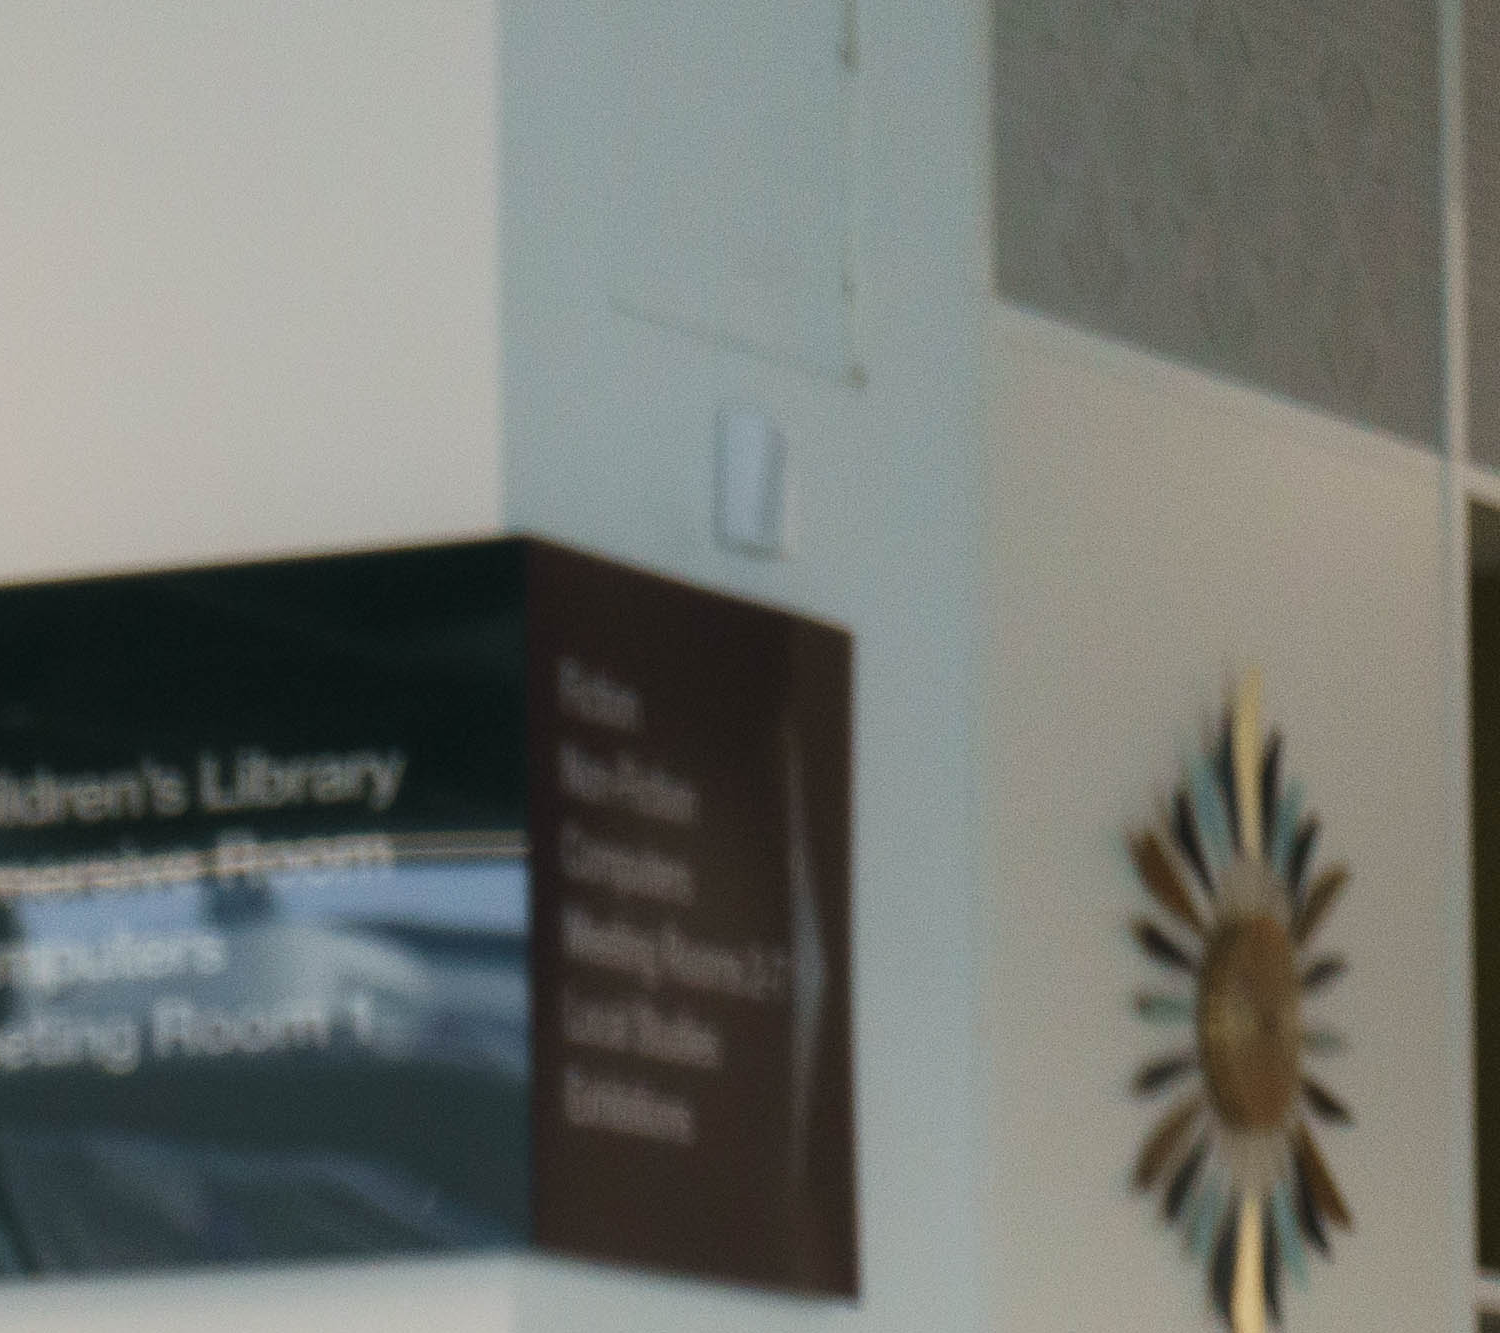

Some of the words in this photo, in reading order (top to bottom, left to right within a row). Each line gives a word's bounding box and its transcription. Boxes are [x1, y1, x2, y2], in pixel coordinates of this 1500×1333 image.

[200, 746, 404, 812] Library
[212, 828, 398, 887] Room
[150, 996, 334, 1058] Room
